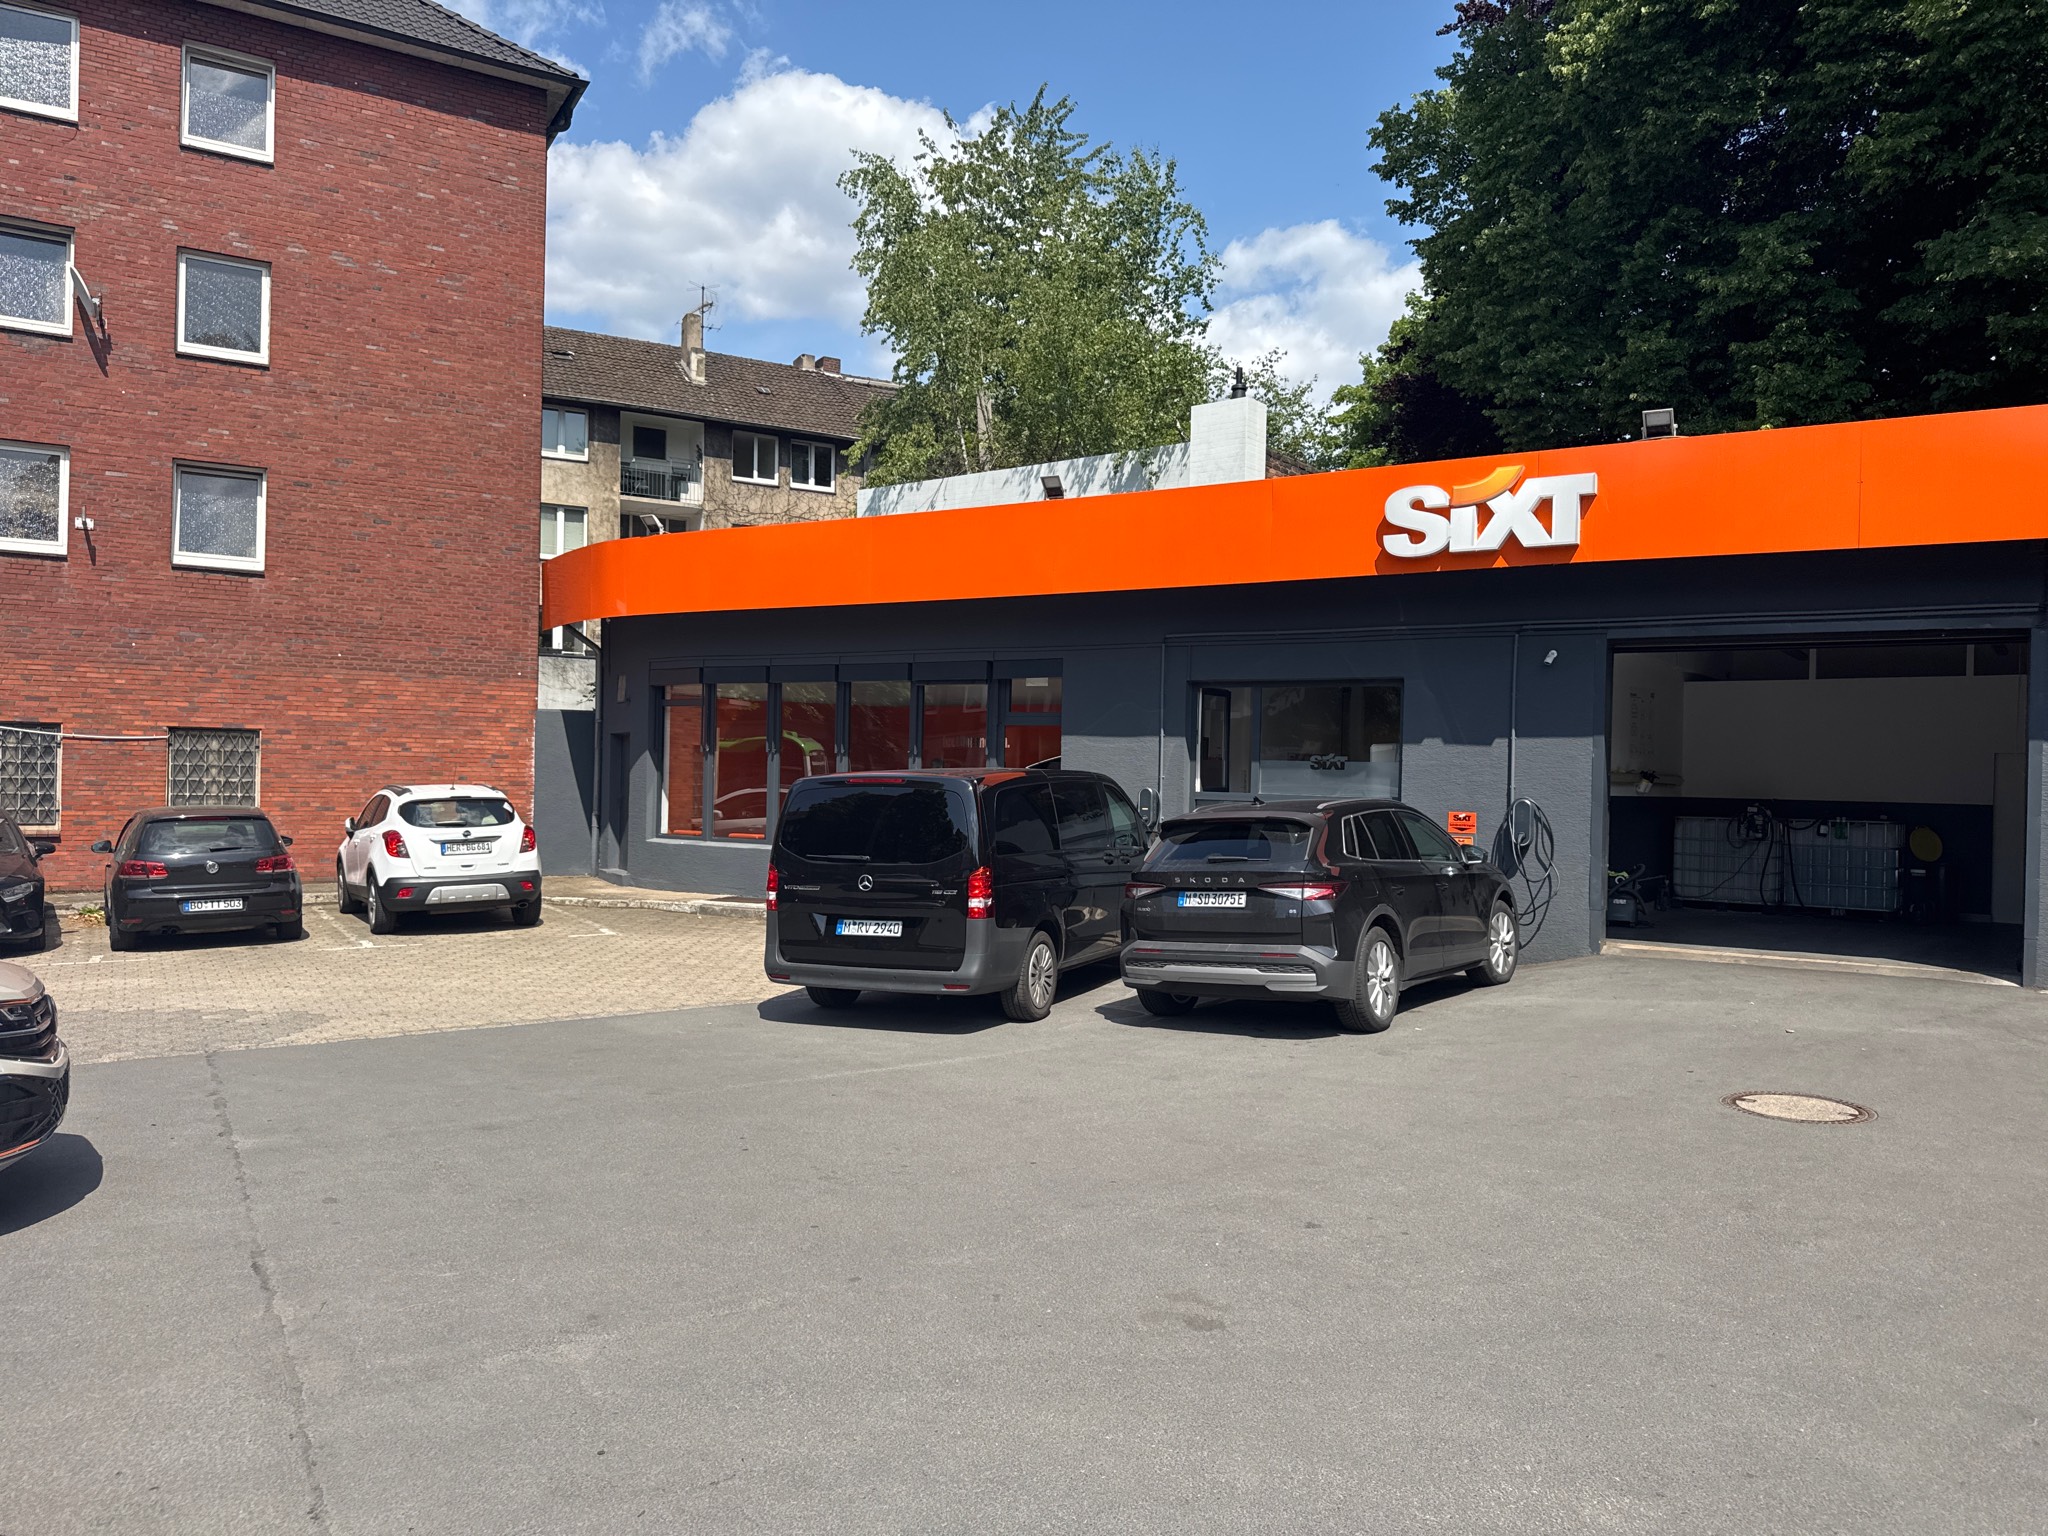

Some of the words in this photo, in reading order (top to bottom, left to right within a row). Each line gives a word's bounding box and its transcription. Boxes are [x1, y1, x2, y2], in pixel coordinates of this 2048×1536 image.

[446, 843, 460, 852] HER
[466, 843, 476, 851] BG
[477, 843, 490, 851] 681
[190, 901, 203, 910] BO
[223, 899, 241, 908] 503
[1185, 893, 1192, 905] M
[843, 921, 851, 933] M
[873, 922, 900, 934] 2940
